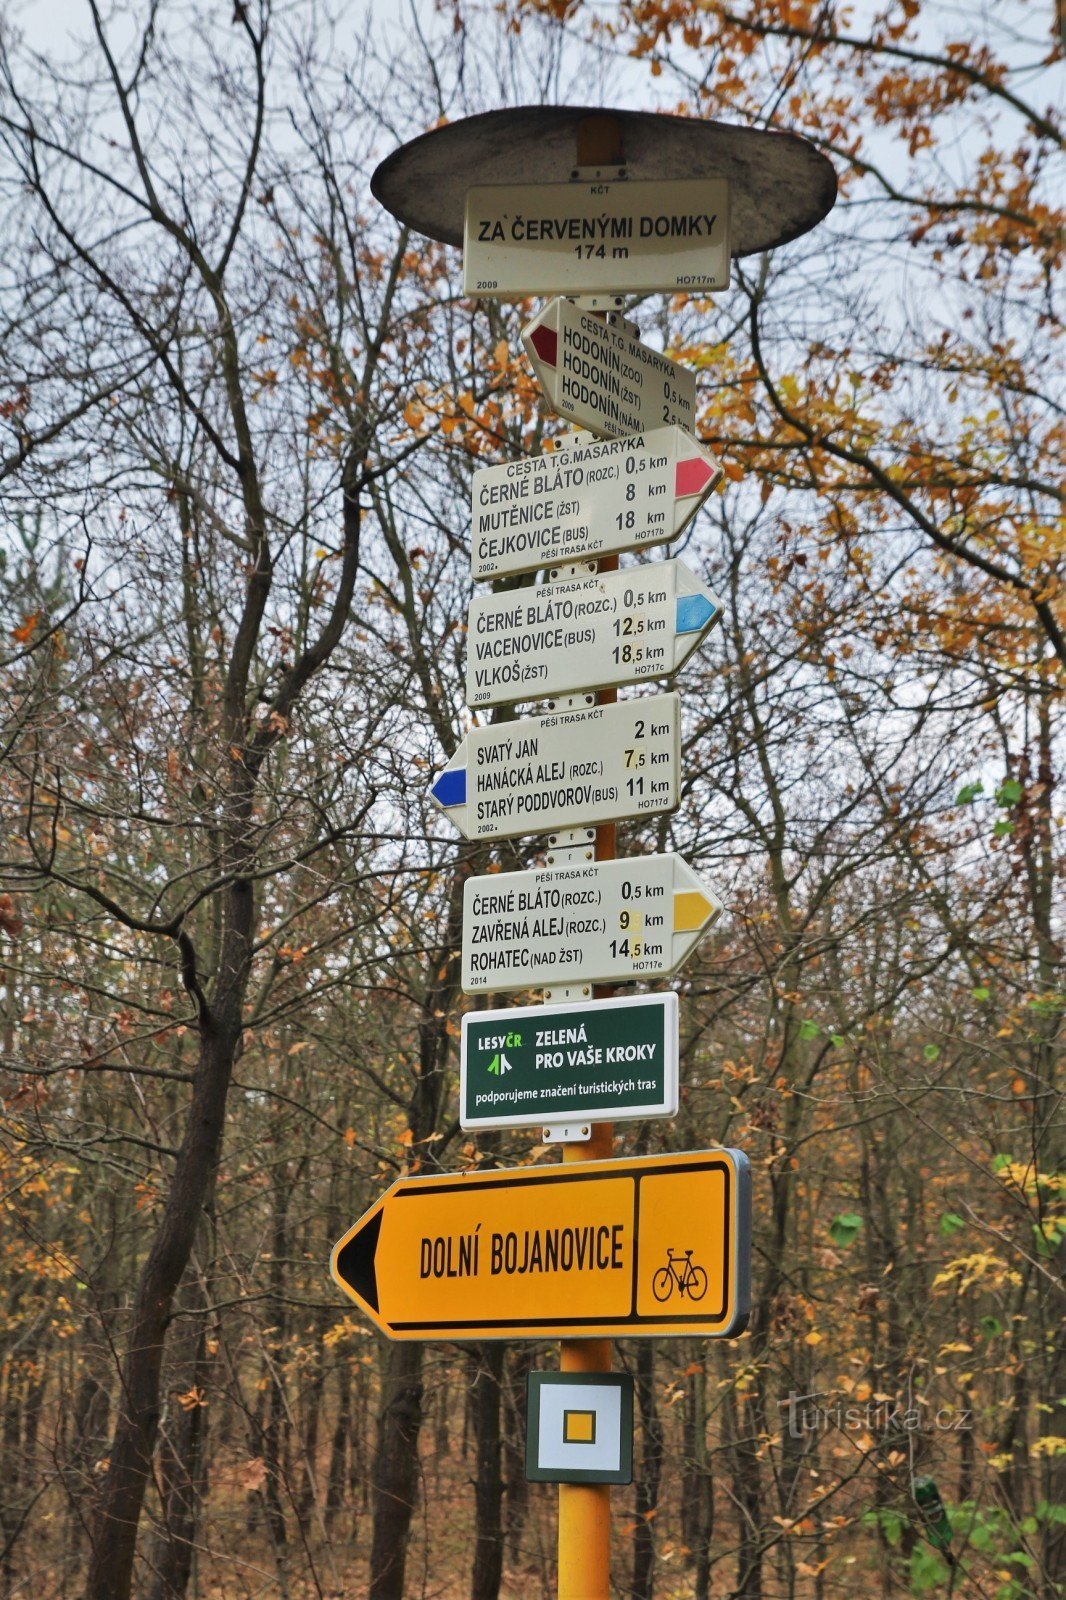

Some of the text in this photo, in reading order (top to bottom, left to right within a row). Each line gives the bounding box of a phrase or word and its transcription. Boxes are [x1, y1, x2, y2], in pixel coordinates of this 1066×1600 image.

[590, 186, 610, 194] KČT
[512, 213, 632, 241] ČERVENÝMI
[640, 215, 717, 237] DOMKY
[575, 245, 628, 260] 174 m
[477, 281, 498, 290] 2009
[676, 276, 716, 286] HO717m
[580, 317, 609, 342] CESTA
[628, 343, 675, 380] MASARYKA
[562, 400, 574, 412] 2009
[664, 382, 676, 404] 0,5
[679, 394, 690, 410] km
[604, 421, 617, 436] PĚŠÍ
[506, 460, 547, 477] CESTA
[480, 456, 668, 506] ČERNÉ BLÁTO (ROZC.) 0,5 km
[480, 484, 666, 533] MUTĚNICE (ŽST) 8 km
[478, 510, 664, 560] ČEJKOVICE (BUS) 18 km
[635, 528, 664, 540] HO717b
[541, 540, 603, 560] PĚŠÍ TRASA KČT
[536, 579, 599, 598] PĚŠÍ TRASA KČT
[476, 606, 522, 634] ČERNÉ
[624, 589, 644, 608] 0,5
[648, 591, 666, 604] km
[612, 617, 644, 637] 12,5
[647, 619, 666, 632] km
[612, 644, 642, 664] 18,5
[646, 647, 664, 660] km
[634, 664, 664, 675] HO717c
[474, 692, 490, 702] 2009
[540, 710, 604, 728] PĚŠÍ TRASA KČT
[477, 720, 669, 765] SVATÝ JAN 2 km
[477, 750, 669, 792] HANÁCKÁ ALEJ (ROZC.) 7,5 km
[477, 793, 513, 820] STARÝ
[626, 777, 644, 796] 11
[651, 781, 669, 793] km
[638, 798, 668, 809] HO717d
[536, 868, 598, 883] PĚŠÍ TRASA KČT
[472, 890, 514, 916] ČERNÉ
[622, 882, 642, 900] 0,5
[646, 884, 664, 897] km
[472, 916, 529, 944] ZAVŘENÁ
[620, 911, 630, 930] 9
[645, 914, 664, 926] km
[558, 948, 582, 964] ŽST)
[610, 939, 640, 959] 14,5
[644, 943, 662, 955] km
[633, 961, 662, 970] HO717e
[471, 976, 486, 985] 2014
[536, 1023, 588, 1046] ZELENÁ
[536, 1044, 656, 1069] PRO VAŠE KROKY
[476, 1079, 656, 1106] podporujeme značení turistických tras
[420, 1224, 623, 1279] DOLNÍ BOJANOVICE
